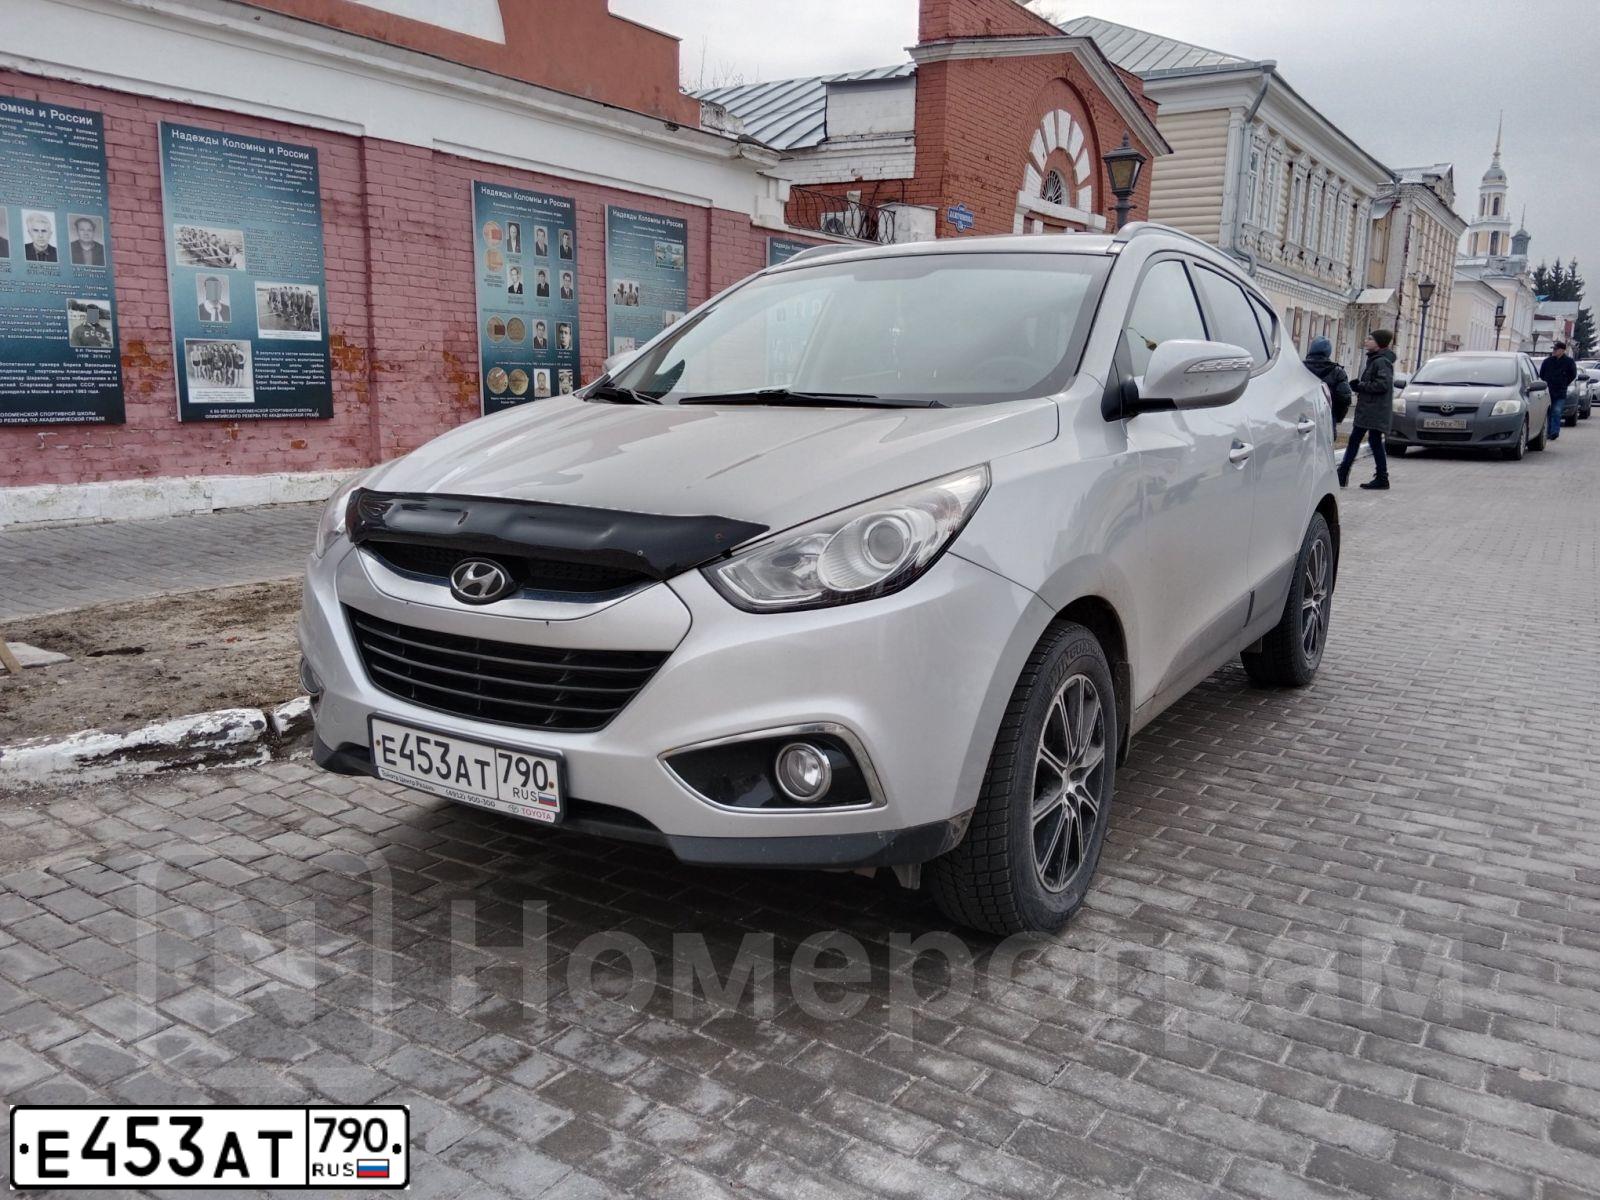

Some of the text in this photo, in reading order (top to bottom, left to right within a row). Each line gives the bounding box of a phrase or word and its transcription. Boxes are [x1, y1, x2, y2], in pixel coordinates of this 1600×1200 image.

[39, 109, 46, 118] и
[50, 109, 93, 126] России
[171, 129, 219, 146] Надежды
[222, 137, 266, 153] Коломны
[277, 146, 310, 160] России
[481, 186, 512, 199] Надежды
[513, 192, 542, 204] Коломны
[549, 198, 571, 209] России
[498, 753, 549, 792] 790
[512, 787, 538, 802] RUS
[521, 807, 552, 821] TOYOTA
